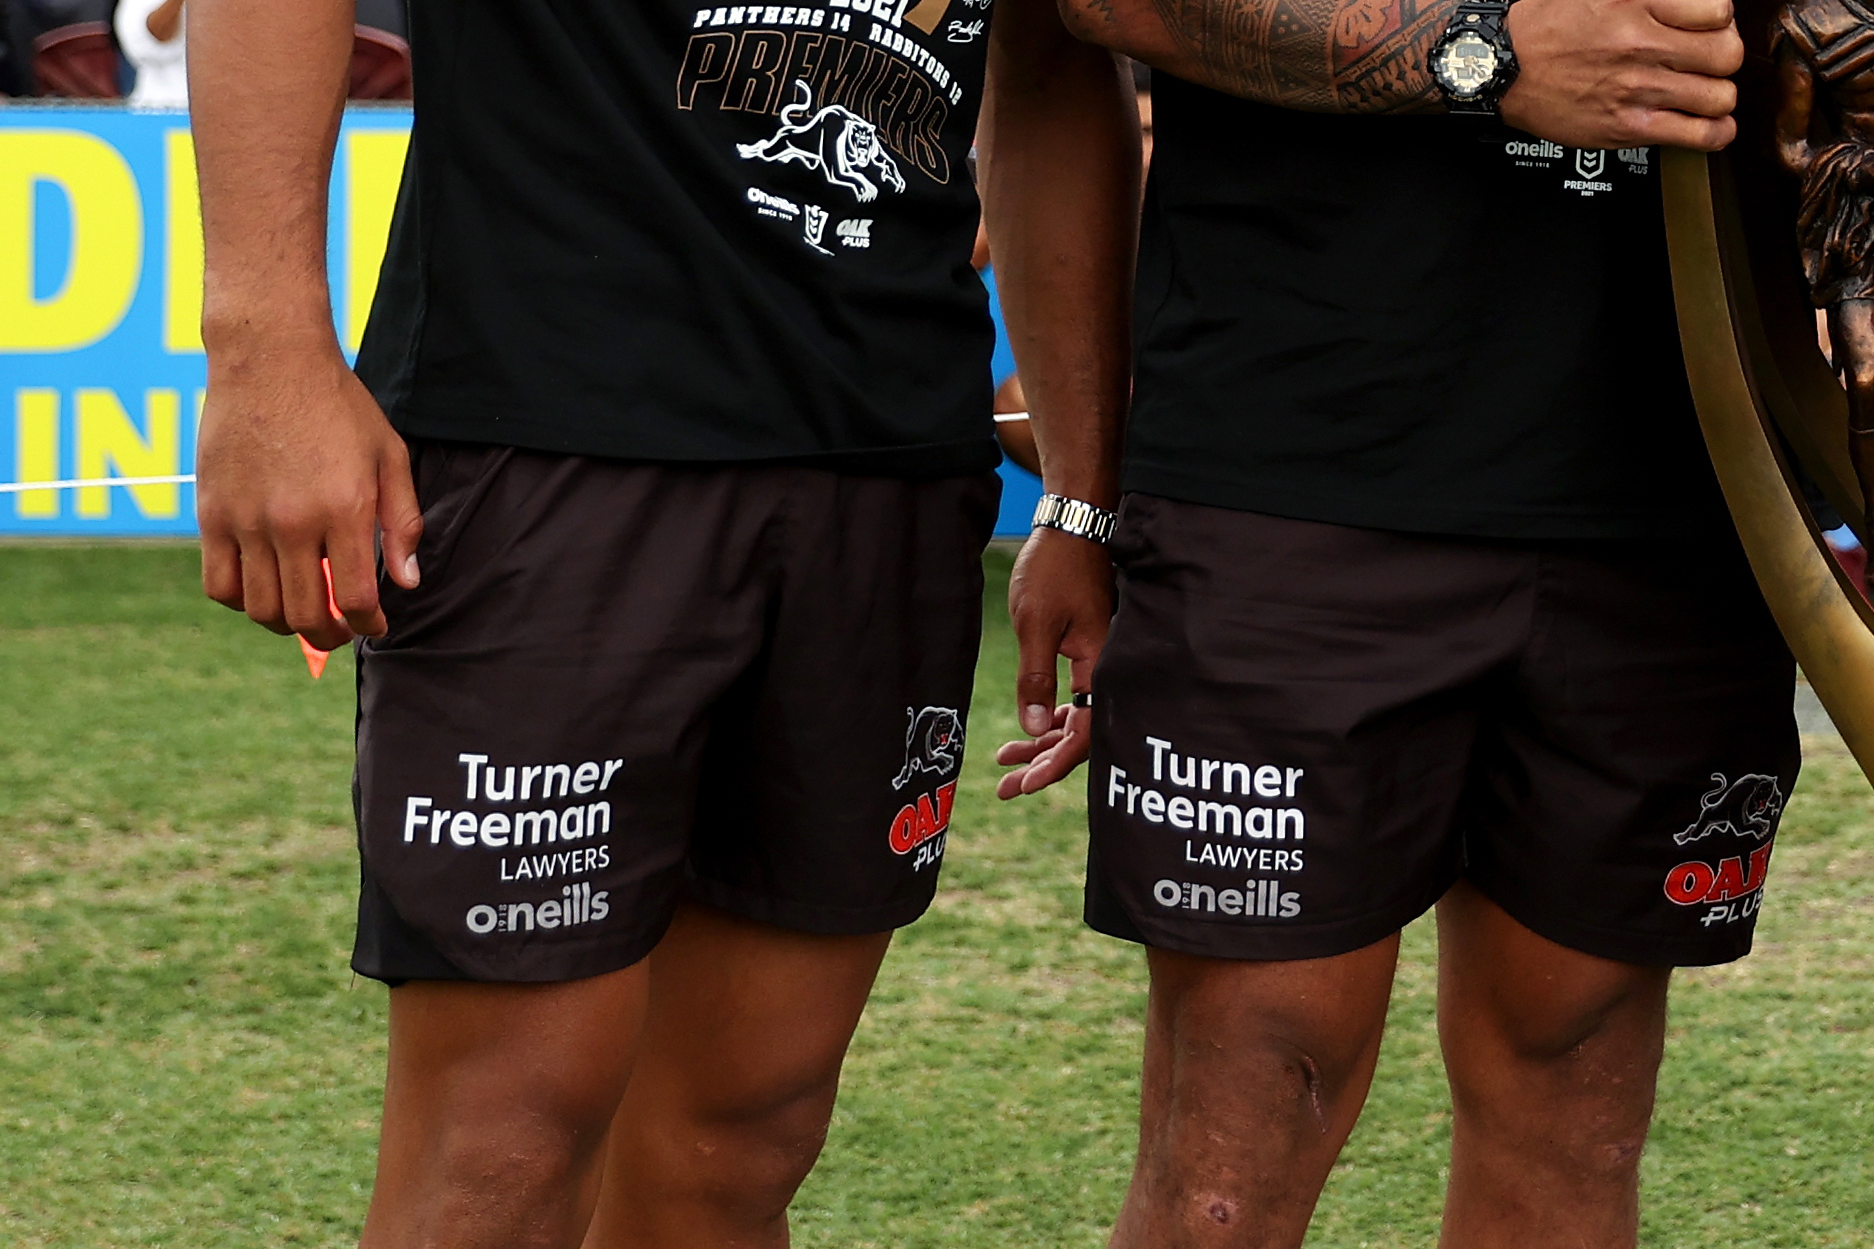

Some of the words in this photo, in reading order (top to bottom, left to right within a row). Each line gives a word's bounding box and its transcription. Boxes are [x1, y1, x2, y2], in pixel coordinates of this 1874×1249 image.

[693, 6, 825, 28] PANTHERS
[831, 14, 851, 32] 14
[869, 26, 950, 97] RABBITOHS
[949, 83, 963, 106] 12
[676, 30, 950, 184] PREMIERS
[1618, 147, 1649, 165] OAK
[1629, 165, 1648, 175] PLUS
[1564, 180, 1612, 191] PREMIERS
[842, 237, 870, 248] PLUS
[458, 753, 623, 801] Turner
[1146, 736, 1304, 797] Turner
[404, 797, 611, 846] Freeman
[1108, 764, 1304, 840] Freeman
[500, 845, 610, 881] LAWYERS
[1186, 840, 1304, 871] LAWYERS
